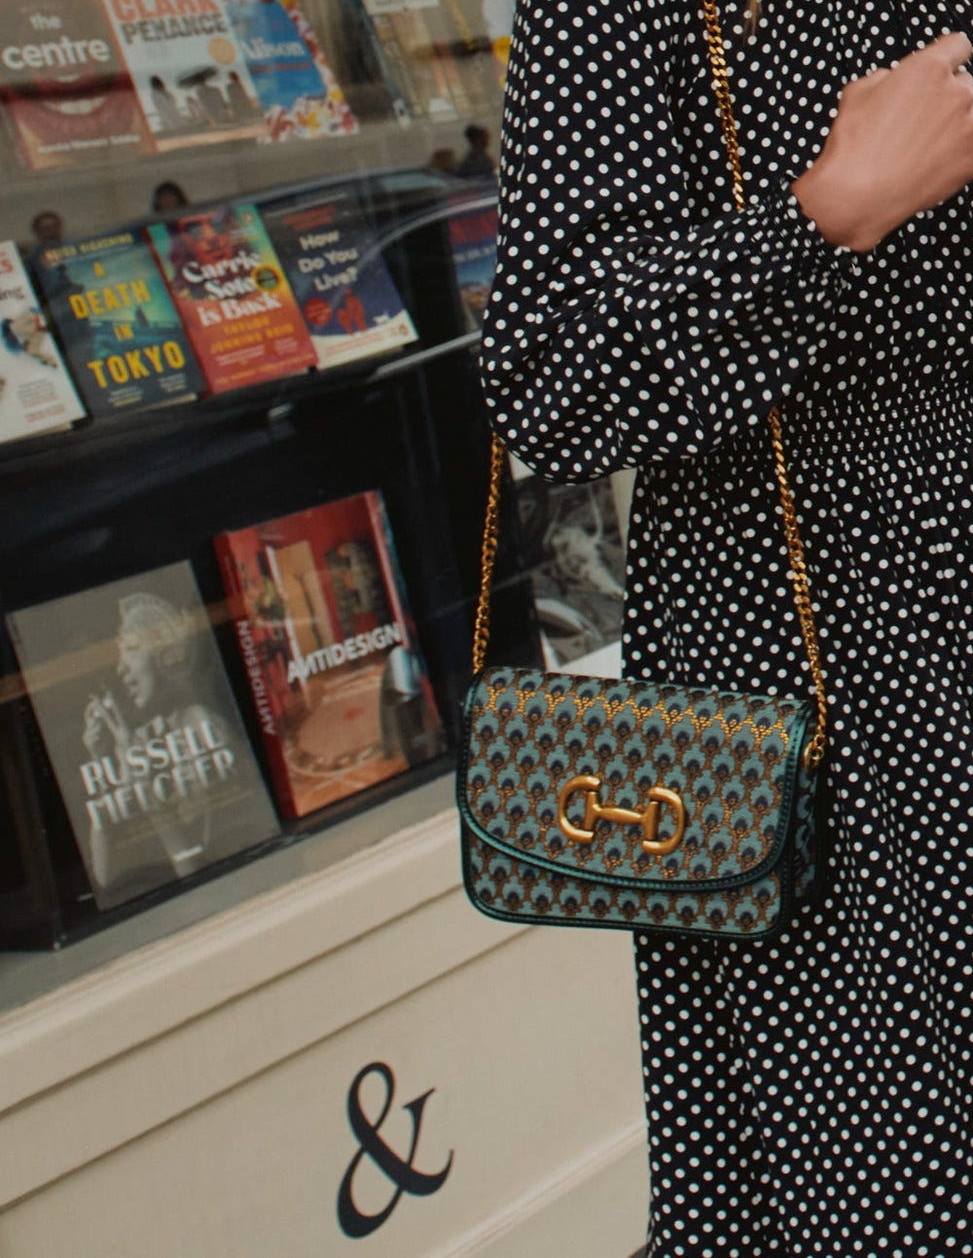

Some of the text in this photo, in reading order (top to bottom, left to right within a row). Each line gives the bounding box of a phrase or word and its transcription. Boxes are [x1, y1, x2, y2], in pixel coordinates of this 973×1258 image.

[29, 11, 62, 30] the
[121, 13, 228, 44] PENANCE
[2, 35, 112, 70] centre
[299, 230, 340, 251] How
[93, 262, 105, 277] A
[182, 250, 260, 283] Carrie
[298, 248, 359, 274] Do You
[204, 276, 257, 301] Soto
[313, 266, 358, 292] Live?
[69, 279, 150, 320] DEATH
[221, 291, 282, 320] Back
[114, 324, 134, 341] IN
[87, 341, 185, 389] TOKYO
[288, 620, 404, 685] ANTIDESIGN
[236, 620, 276, 736] ANTIDESIGN
[80, 719, 225, 795] RUSSELL
[337, 1061, 454, 1240] &
